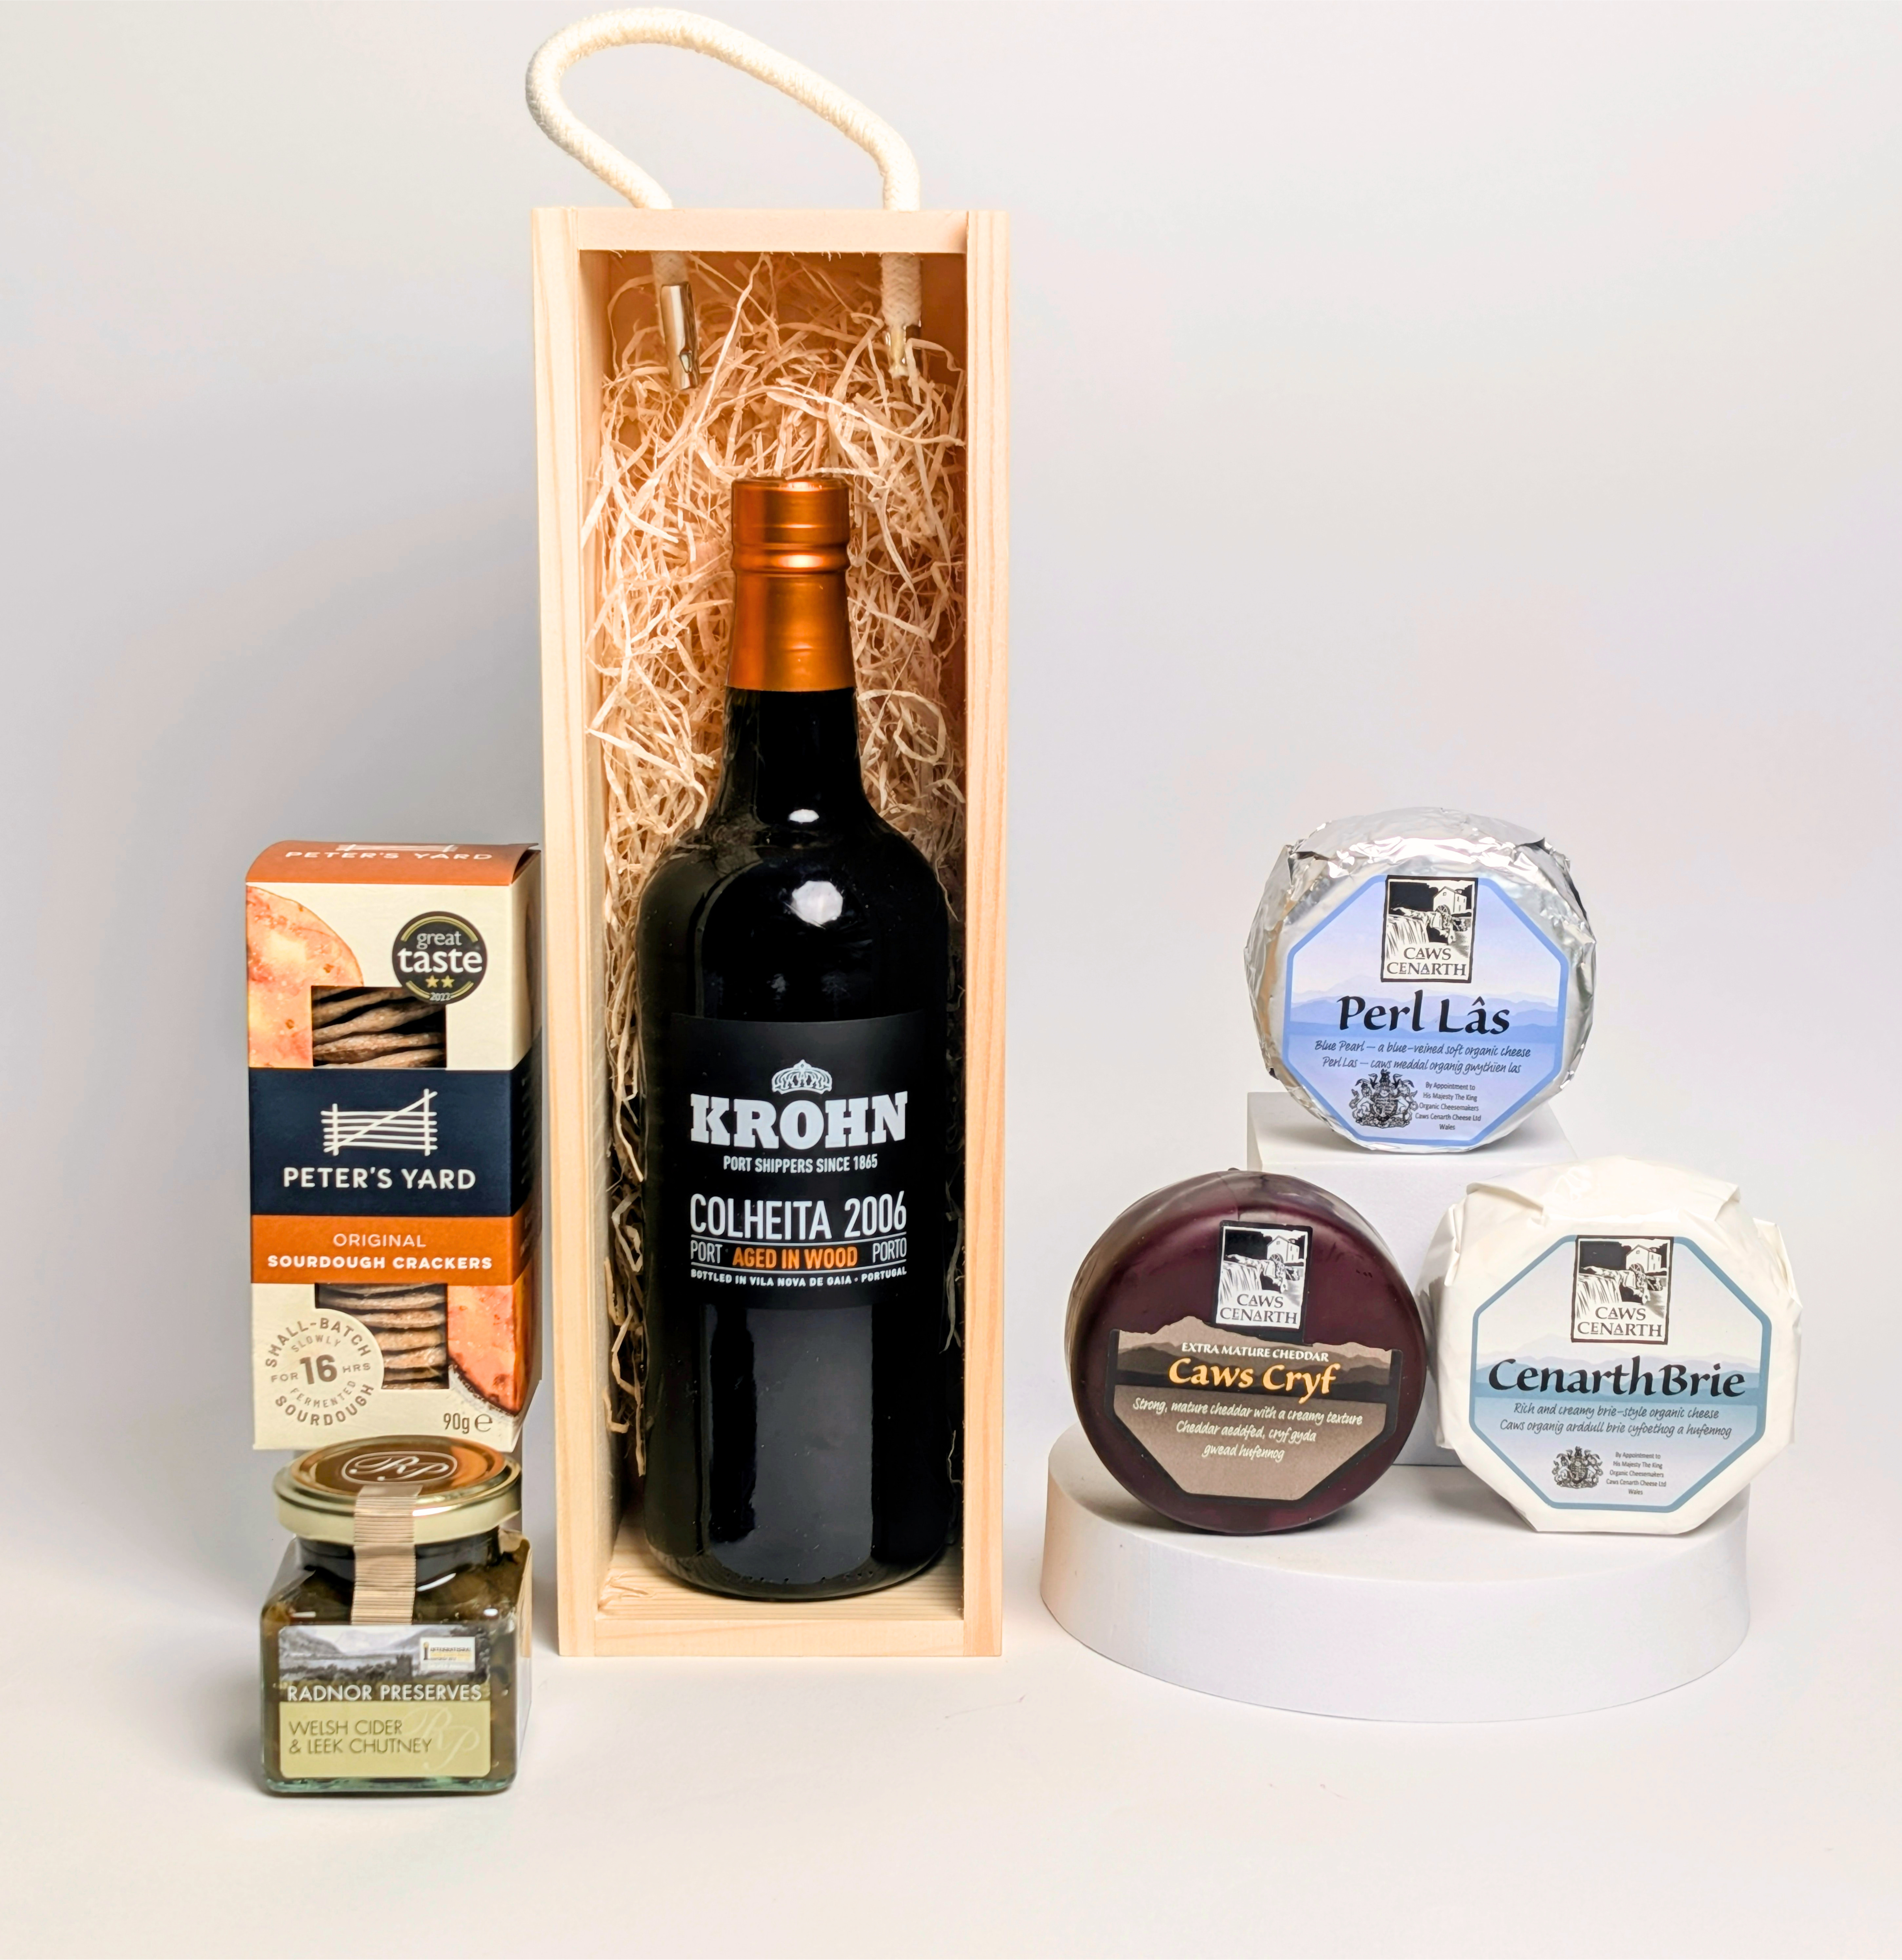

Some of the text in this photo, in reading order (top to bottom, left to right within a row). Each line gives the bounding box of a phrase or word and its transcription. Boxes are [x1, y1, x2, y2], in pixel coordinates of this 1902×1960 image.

[416, 931, 462, 949] great
[397, 948, 482, 973] taste
[1403, 947, 1451, 960] CAWS
[1387, 962, 1466, 976] CENARTH
[1337, 989, 1510, 1034] Perl Lâs
[1315, 1040, 1337, 1050] Blue
[1339, 1041, 1365, 1051] Pearl
[1378, 1044, 1385, 1052] a
[1445, 1044, 1464, 1057] soft
[1465, 1045, 1498, 1059] organic
[1501, 1045, 1530, 1057] cheese
[1322, 1056, 1342, 1067] Perl
[1342, 1057, 1358, 1067] Las
[1370, 1059, 1391, 1069] caws
[1393, 1059, 1429, 1070] meddal
[1429, 1061, 1463, 1074] organig
[1508, 1062, 1522, 1073] las
[1419, 1102, 1439, 1110] Organic
[1432, 1093, 1453, 1101] Majesty
[690, 1091, 908, 1150] KROHN
[723, 1153, 878, 1173] PORT SHIPPERS SINCE 1865
[283, 1167, 475, 1189] PETER'S YARD
[691, 1191, 907, 1240] COLHEITA 2006
[333, 1234, 426, 1247] ORIGINAL
[268, 1256, 492, 1269] SOURDOUGH CRACKERS
[691, 1237, 907, 1269] PORT AGED IN WOOD PORTO
[691, 1266, 907, 1287] BOTTLED IN VILA NOVA DE GAIA PORTUGAL
[1237, 1293, 1283, 1308] CAWS
[1220, 1307, 1297, 1324] CENARTH
[1595, 1307, 1646, 1320] CAWS
[1577, 1322, 1663, 1337] CENARTH
[265, 1317, 371, 1368] SMALL-BATCH
[291, 1335, 341, 1352] SLOWLY
[1182, 1342, 1329, 1362] EXTRA MATURE CHEDDAR
[271, 1354, 371, 1385] FOR 16 HRS
[1169, 1358, 1341, 1404] Caws Cryf
[290, 1381, 356, 1408] FERMENTED
[275, 1384, 374, 1426] SOURDOUGH
[1133, 1397, 1363, 1426] Strong, mature cheddar with a creamy texture
[1514, 1402, 1535, 1414] Rich
[1537, 1403, 1557, 1414] and
[1558, 1407, 1595, 1419] creamy
[1649, 1407, 1684, 1420] organic
[1688, 1407, 1719, 1419] cheese
[444, 1413, 470, 1434] 90g
[1176, 1420, 1317, 1444] Cheddar aeddfed, cryf gyda
[1500, 1419, 1732, 1439] Caws organig arddull brie cyfoethog a hufennog
[1201, 1444, 1285, 1463] gwead hufennog
[287, 1684, 482, 1701] RADNOR PRESERVES
[289, 1720, 402, 1736] WELSH CIDER
[289, 1738, 432, 1754] & LEEK CHUTNEY
